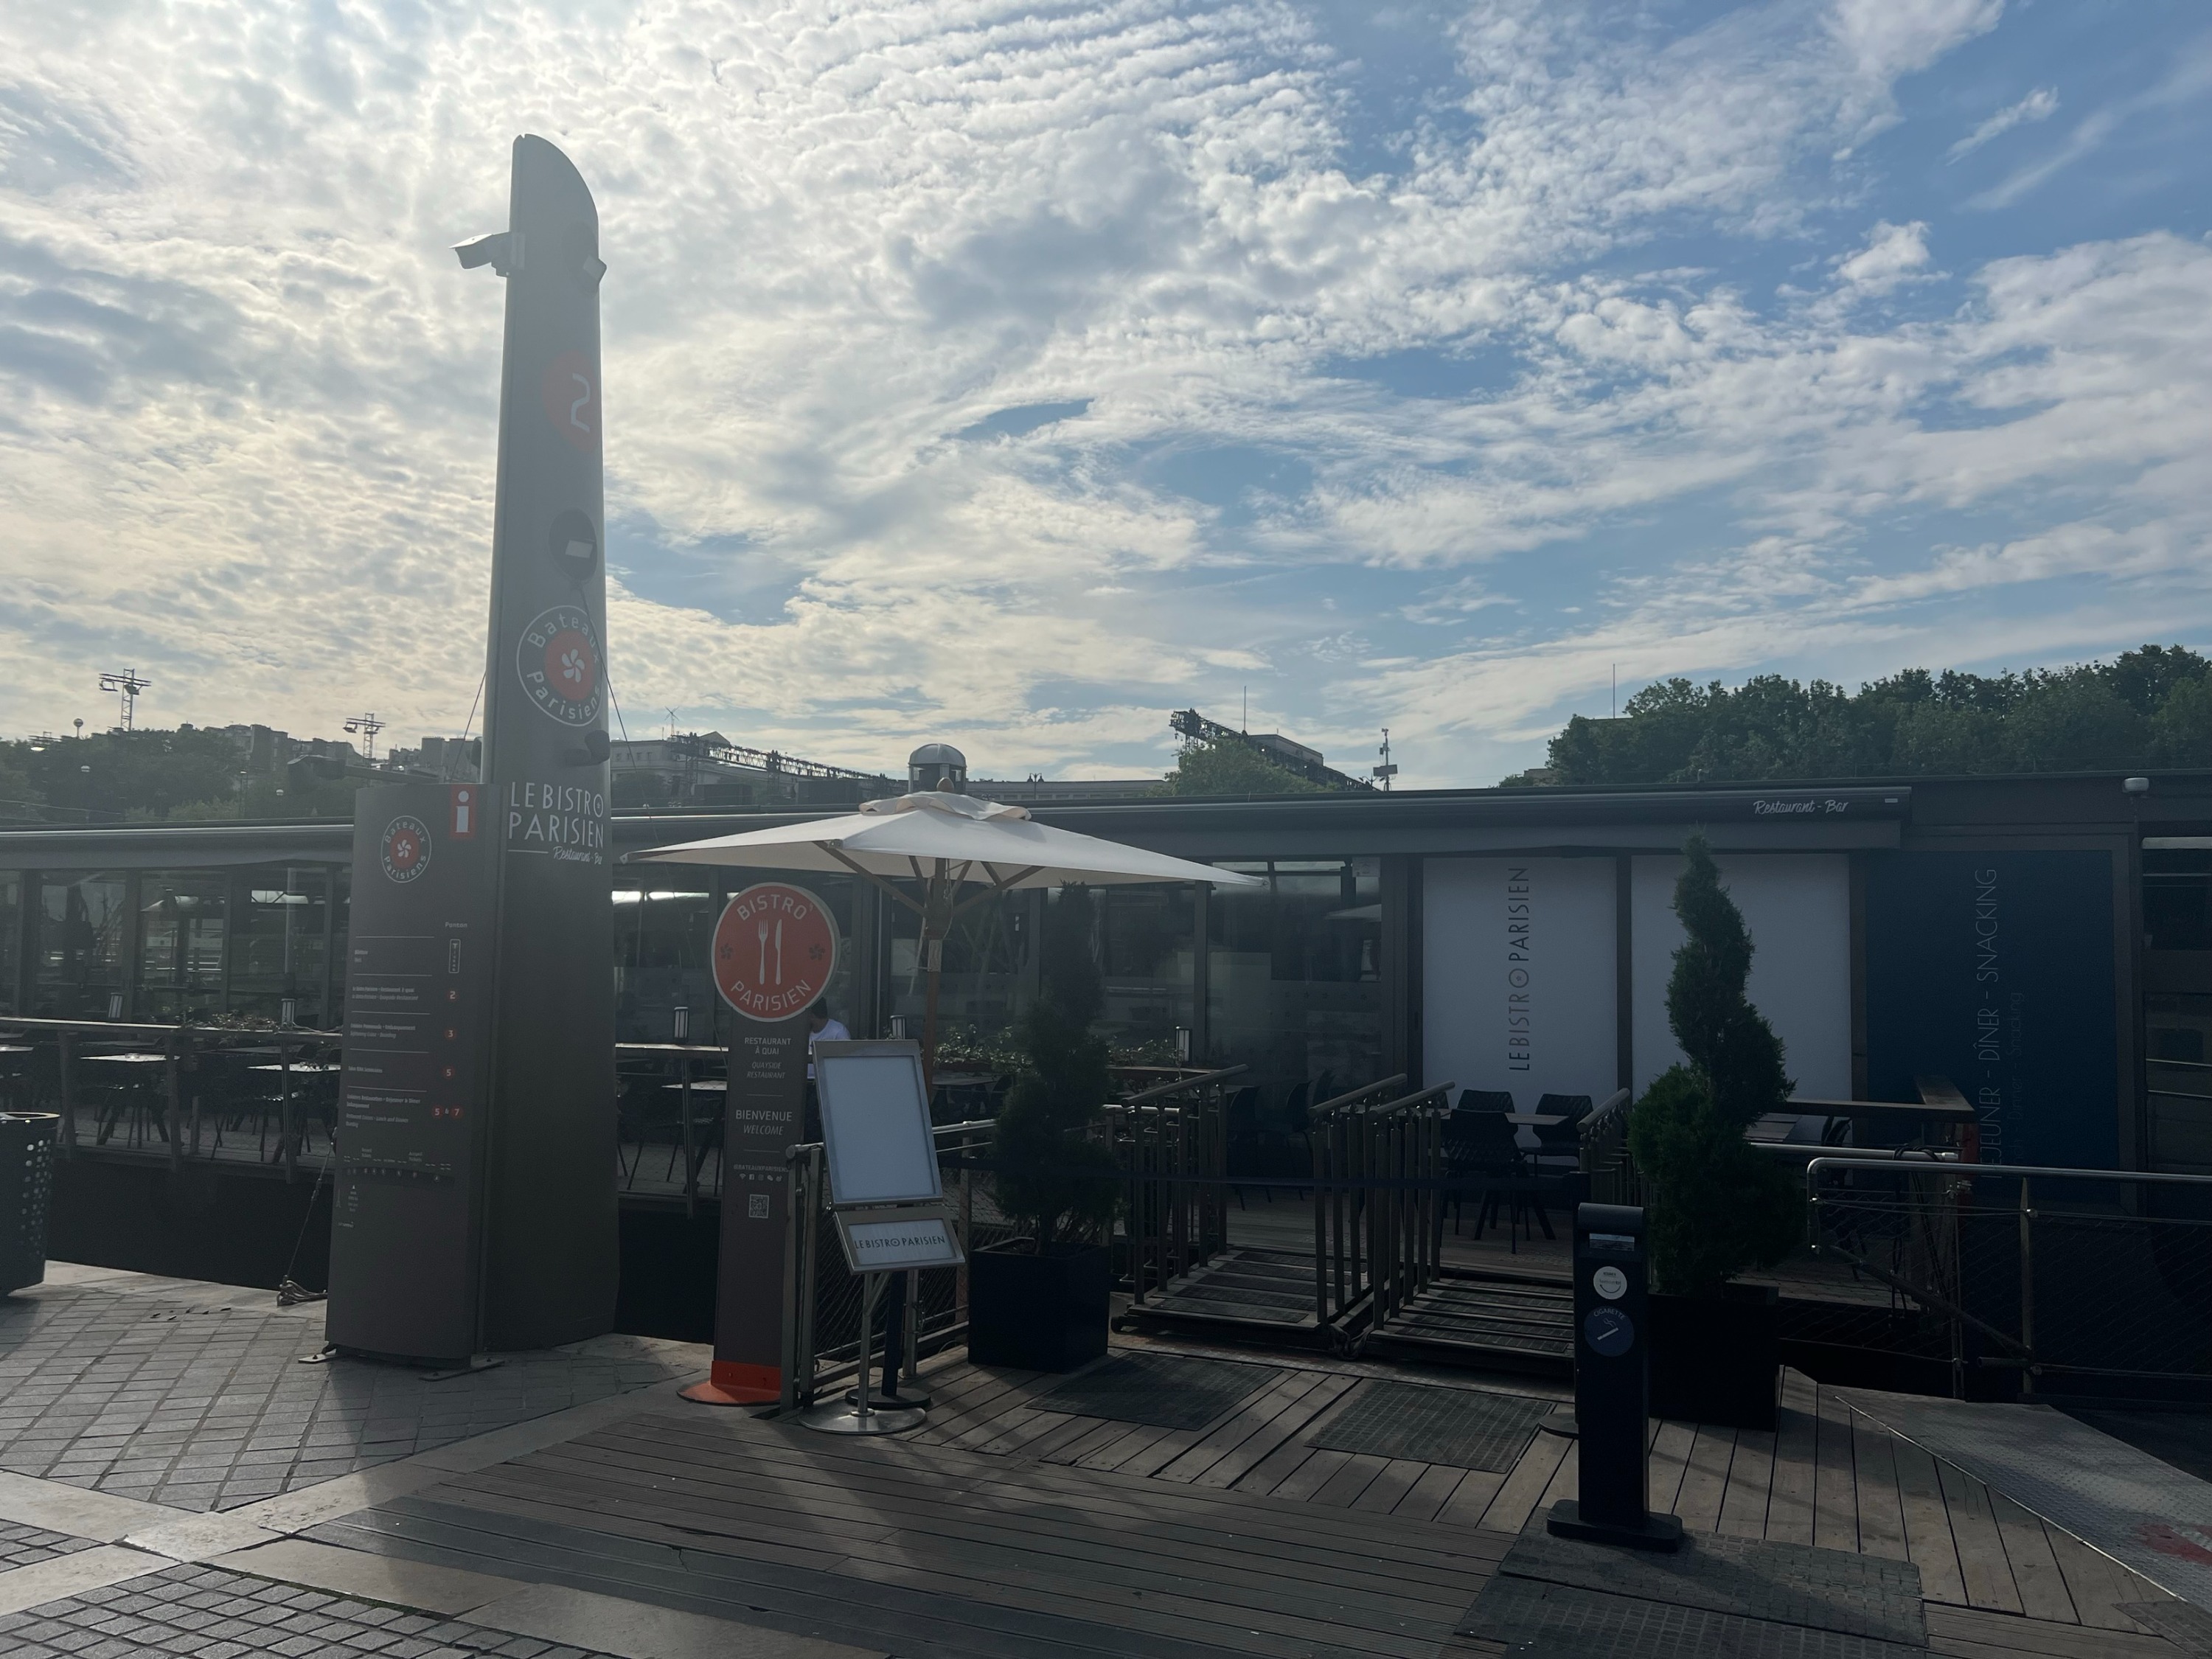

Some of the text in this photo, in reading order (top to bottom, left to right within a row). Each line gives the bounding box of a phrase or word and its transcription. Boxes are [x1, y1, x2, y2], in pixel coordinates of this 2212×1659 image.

[526, 671, 599, 720] Parisiens
[510, 782, 604, 818] LE BISTRO
[1753, 800, 1815, 815] Restaurant
[1824, 799, 1848, 813] Bar
[384, 821, 426, 844] Bateaux
[508, 811, 604, 849] PARISIEN
[383, 855, 427, 880] Parisiens
[1974, 869, 1999, 983] SNACKING
[1508, 867, 1530, 1071] LE BISTRO PARISIEN
[449, 990, 456, 1000] 2
[730, 978, 812, 1012] PARISIEN
[448, 1029, 454, 1038] 3
[1972, 1009, 2000, 1061] DÎNER
[744, 1037, 791, 1046] RESTAURANT
[755, 1046, 779, 1055] À QUAI
[751, 1061, 782, 1070] QUAYSIDE
[446, 1068, 452, 1077] 5
[746, 1071, 786, 1079] RESTAURANT
[453, 1107, 460, 1116] 7
[735, 1109, 793, 1122] BIENVENUE
[742, 1124, 785, 1136] WELCOME
[855, 1236, 945, 1249] LE BISTRO PARISIEN
[1593, 1308, 1625, 1321] CIGARETTE
